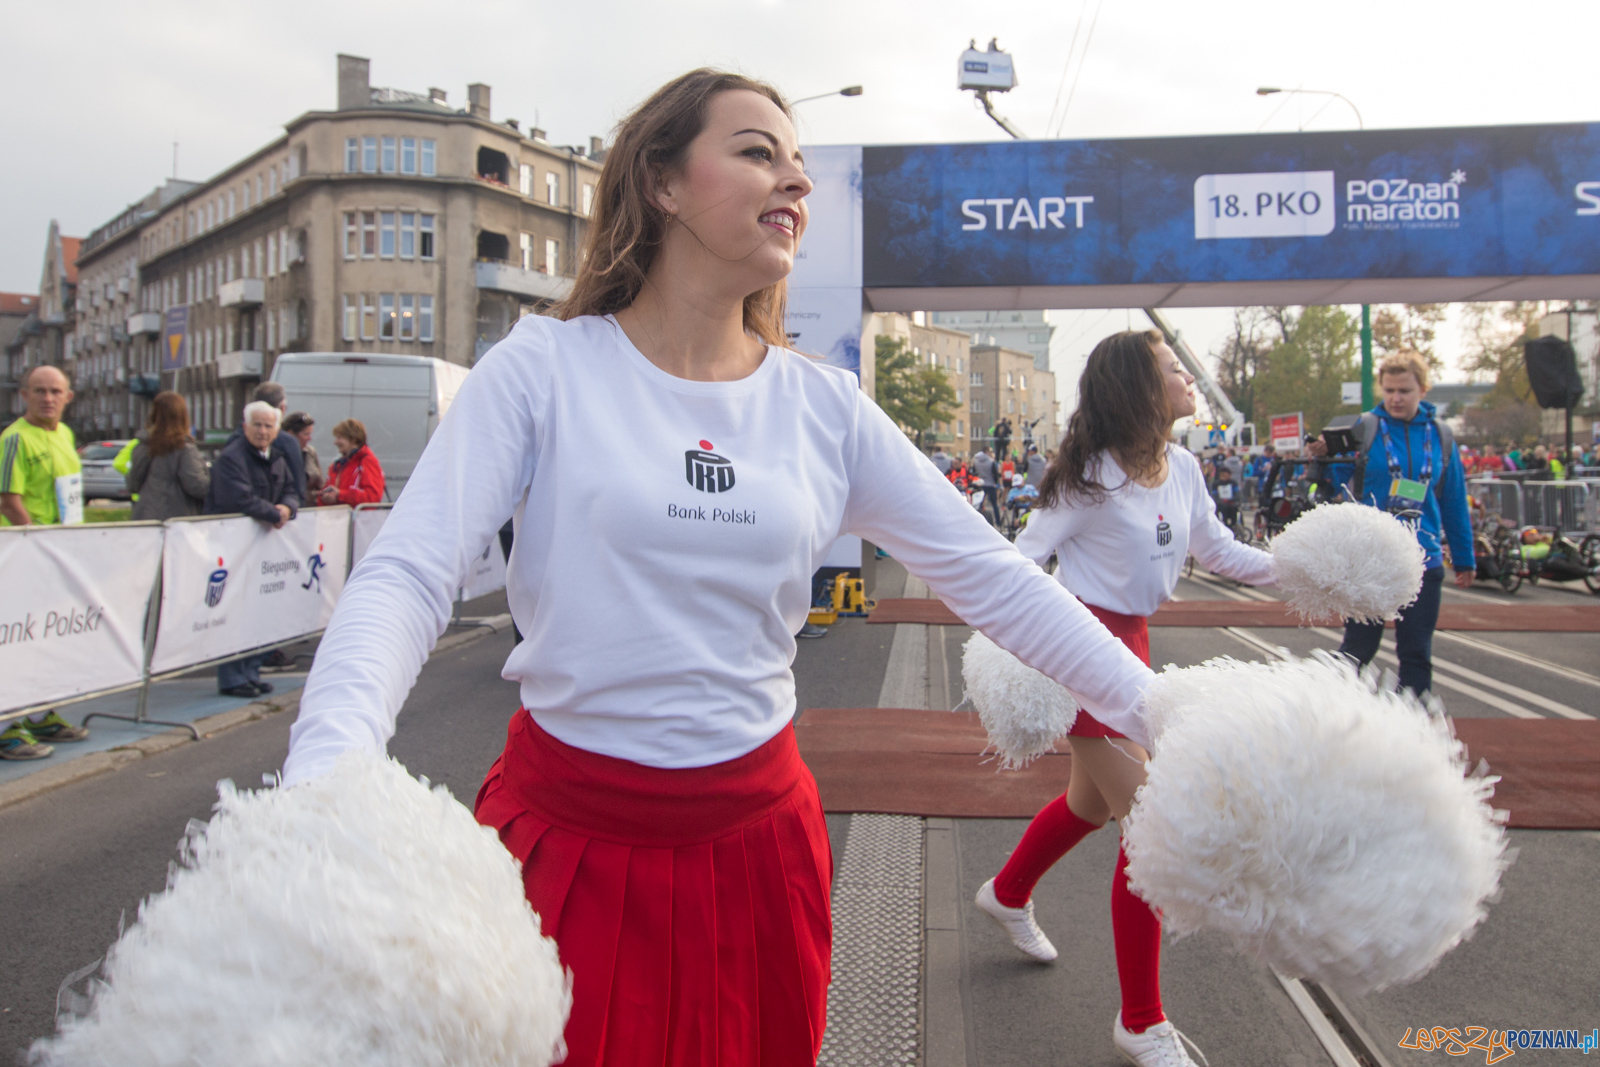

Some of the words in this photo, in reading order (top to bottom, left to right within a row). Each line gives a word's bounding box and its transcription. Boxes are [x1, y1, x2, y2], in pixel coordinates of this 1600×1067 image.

[961, 195, 1094, 231] START
[1208, 194, 1248, 218] 18.
[1256, 191, 1321, 216] PKO
[1347, 198, 1460, 222] maraton
[667, 503, 706, 521] Bank
[712, 507, 757, 525] Polski
[43, 605, 104, 639] Polski
